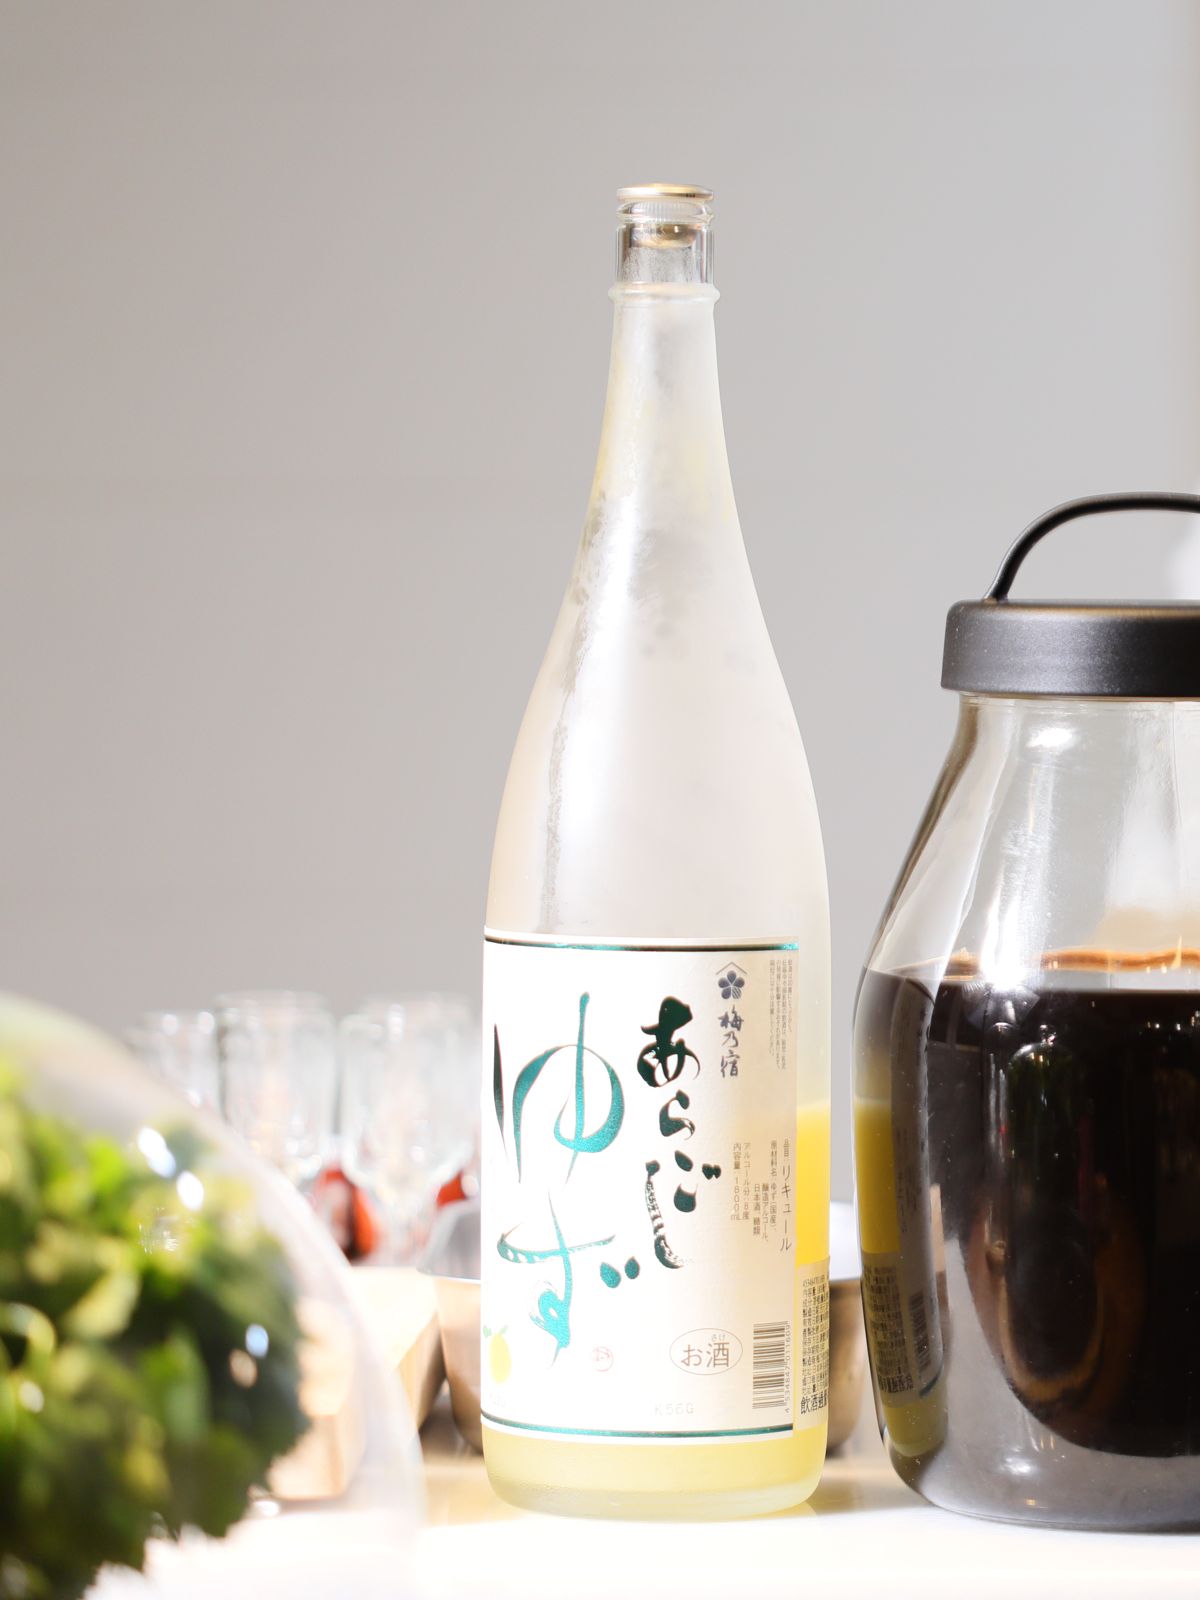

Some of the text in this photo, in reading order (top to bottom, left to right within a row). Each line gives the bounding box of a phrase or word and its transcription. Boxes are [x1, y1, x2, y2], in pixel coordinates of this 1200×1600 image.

[718, 1004, 744, 1078] 梅乃宿
[780, 1164, 793, 1252] リキュール
[681, 1342, 729, 1368] お酒
